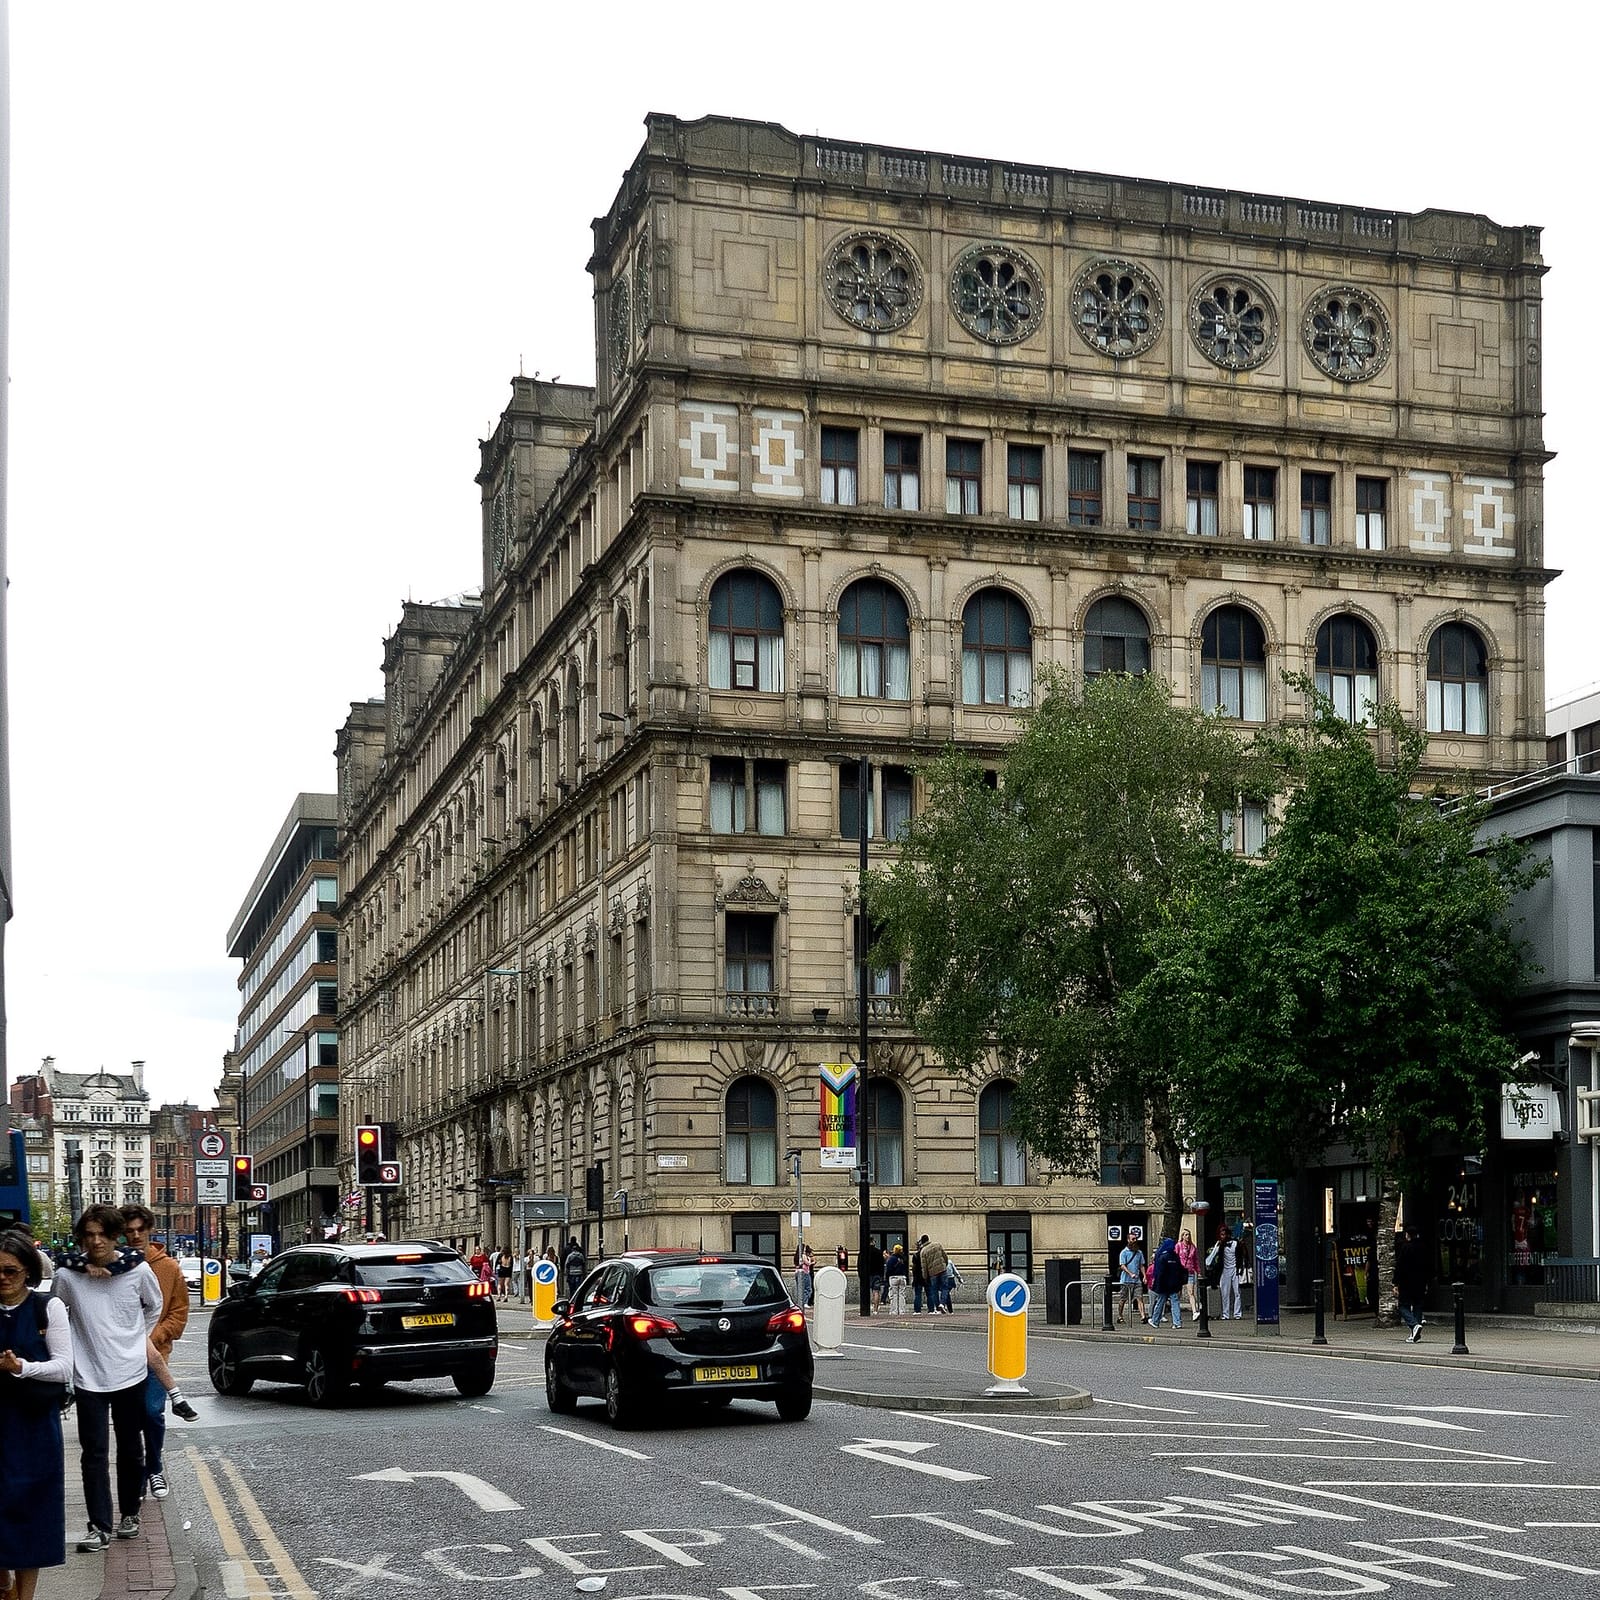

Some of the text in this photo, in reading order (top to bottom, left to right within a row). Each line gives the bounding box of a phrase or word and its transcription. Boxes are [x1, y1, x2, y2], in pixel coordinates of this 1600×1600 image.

[1345, 1256, 1361, 1265] THE
[431, 1314, 449, 1324] NYX
[702, 1367, 751, 1379] DP15 OGB
[871, 1494, 1366, 1545] TURN
[1008, 1535, 1600, 1600] RIGHT
